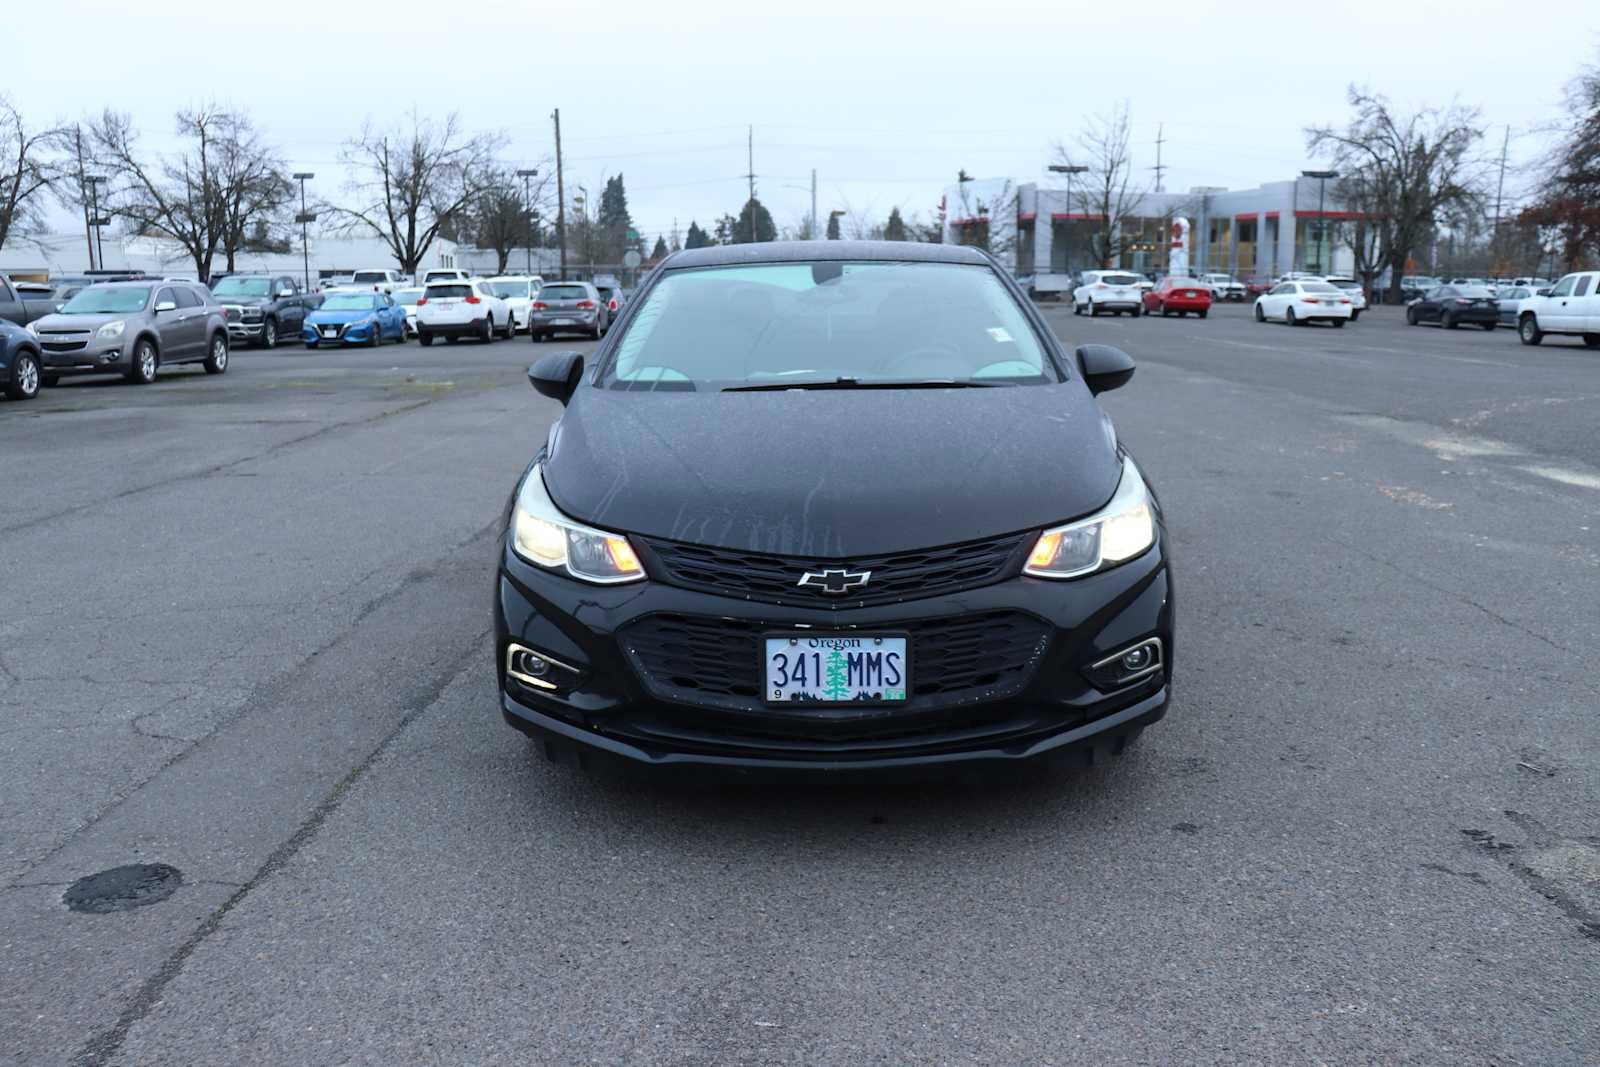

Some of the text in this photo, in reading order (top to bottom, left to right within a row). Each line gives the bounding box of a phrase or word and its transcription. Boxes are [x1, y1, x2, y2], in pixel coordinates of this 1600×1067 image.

[808, 638, 861, 651] Oregon
[772, 652, 901, 687] 341 MMS
[774, 689, 782, 699] 9
